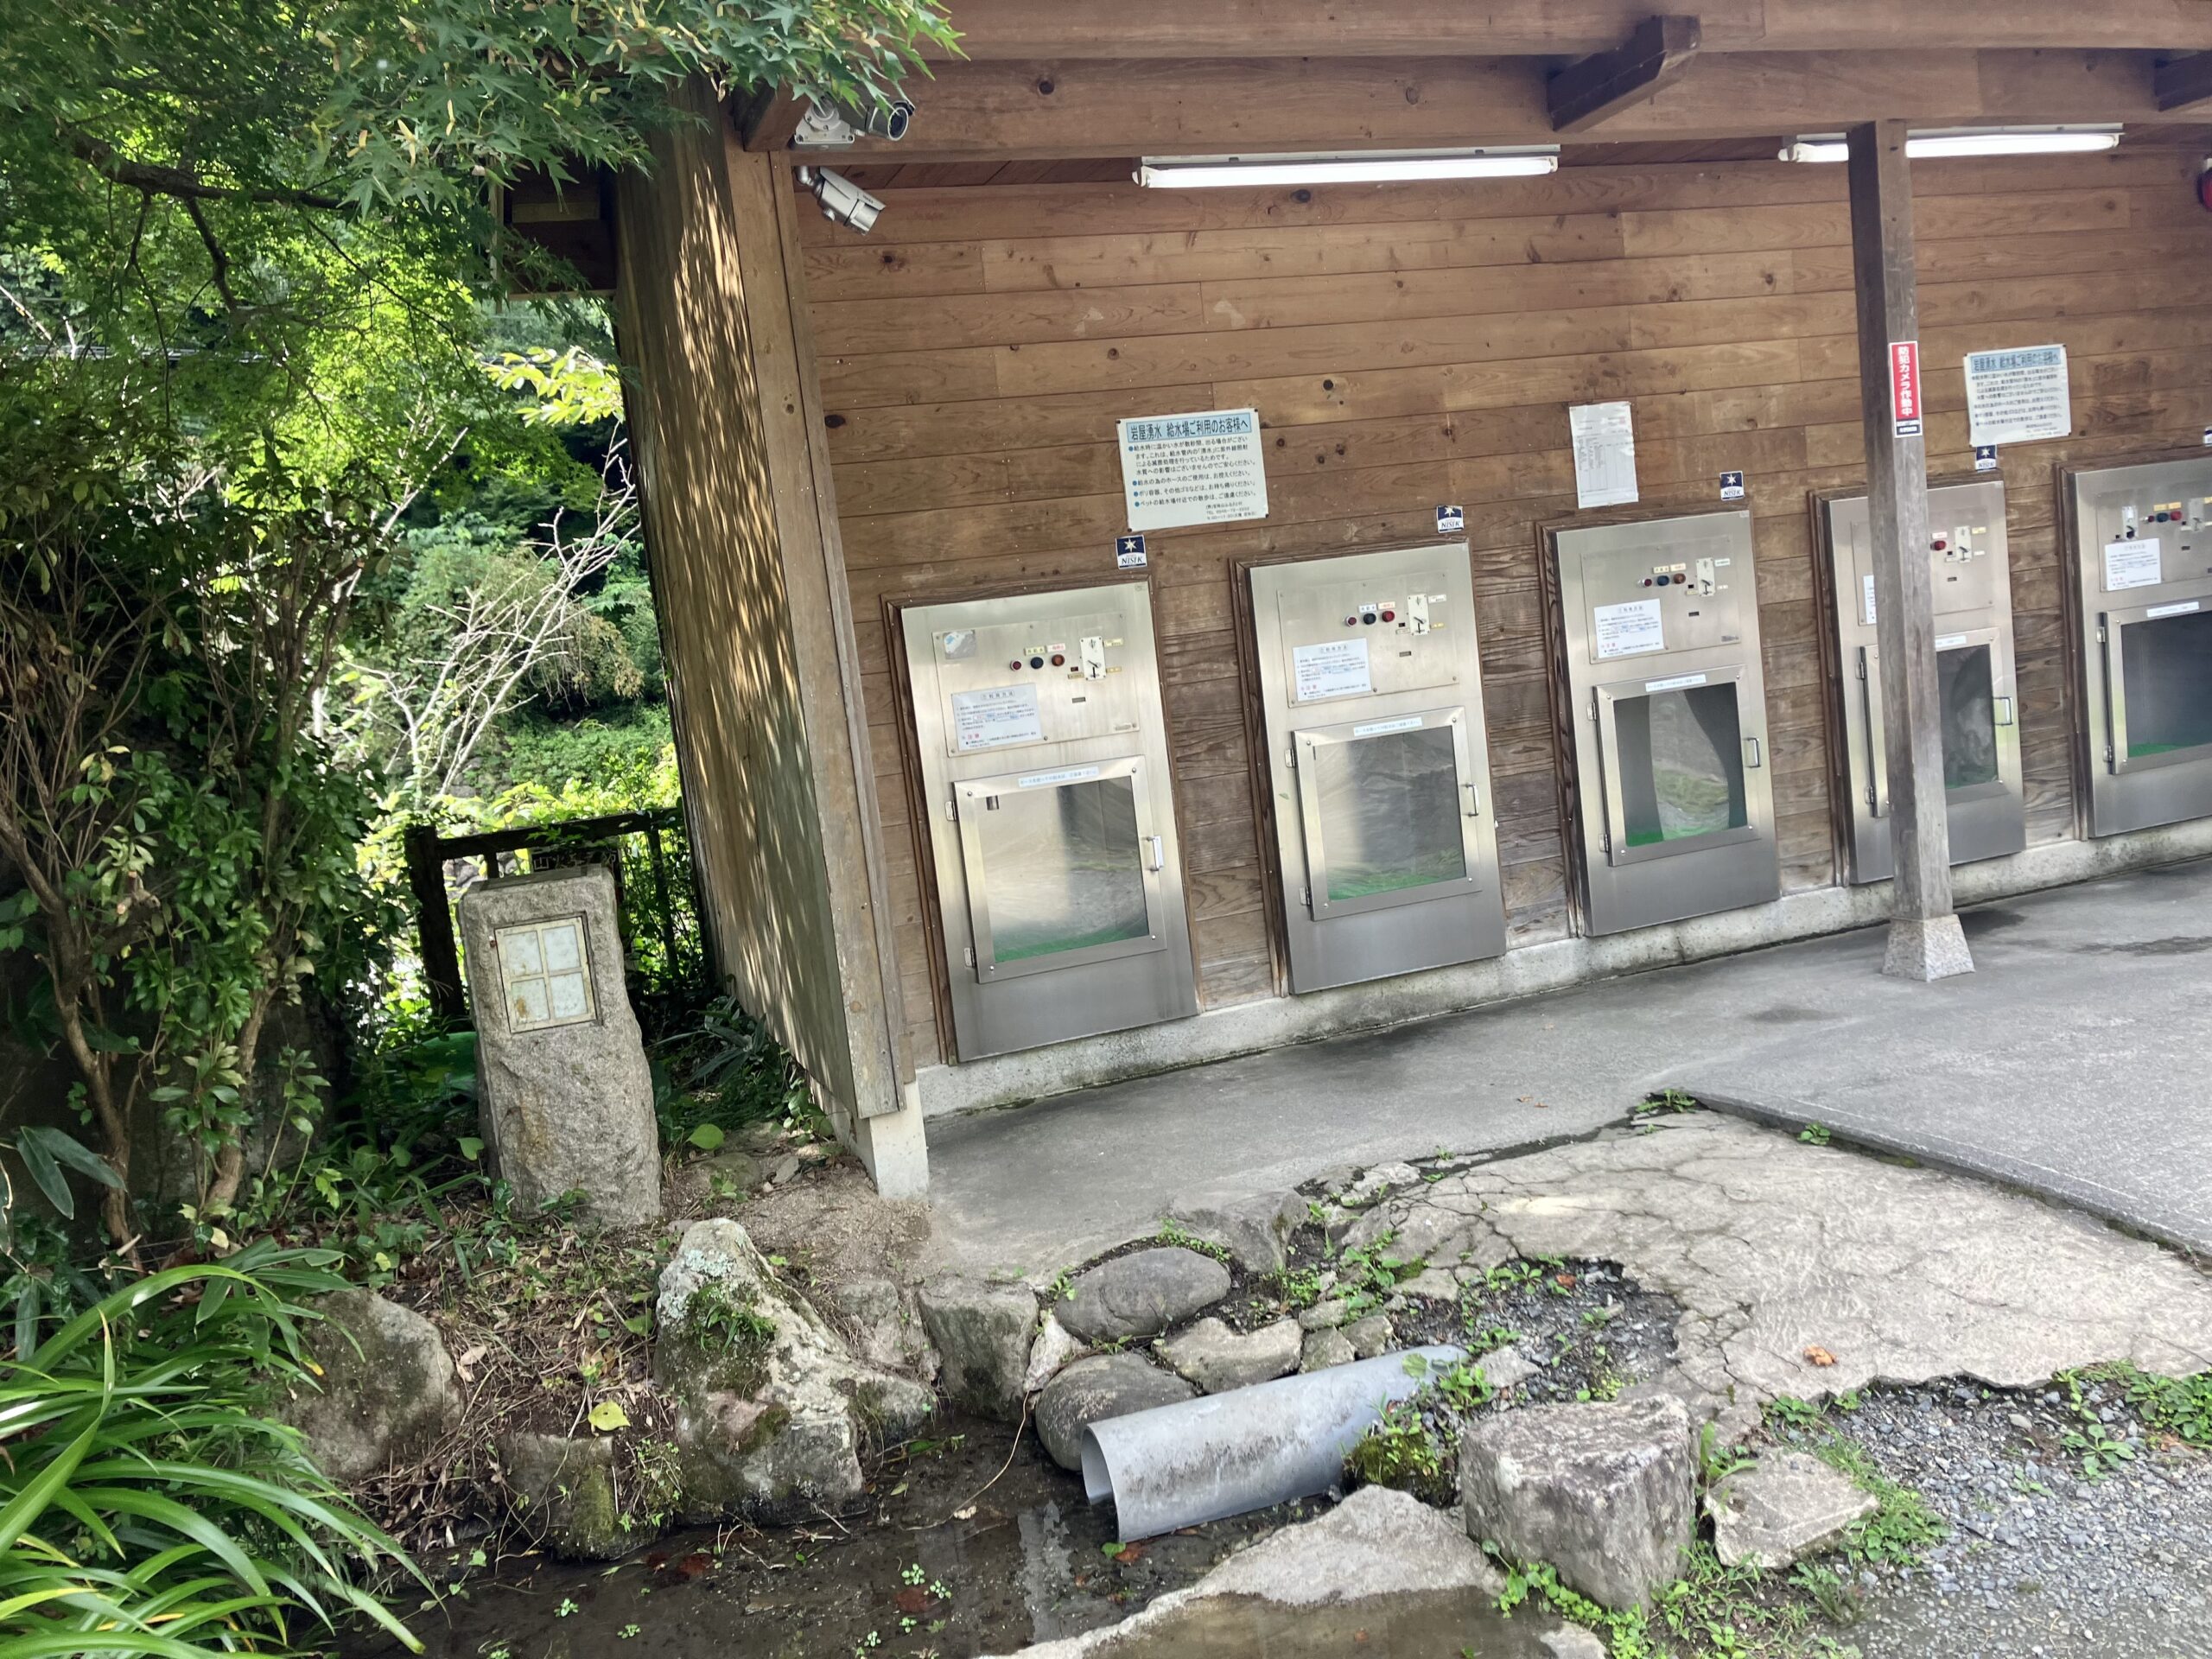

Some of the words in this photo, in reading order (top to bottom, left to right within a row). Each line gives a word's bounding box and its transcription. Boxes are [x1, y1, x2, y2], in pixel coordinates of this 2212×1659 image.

[1131, 424, 1161, 440] 岩屋湧水
[1166, 418, 1248, 437] 給水場ご利用のお客様へ
